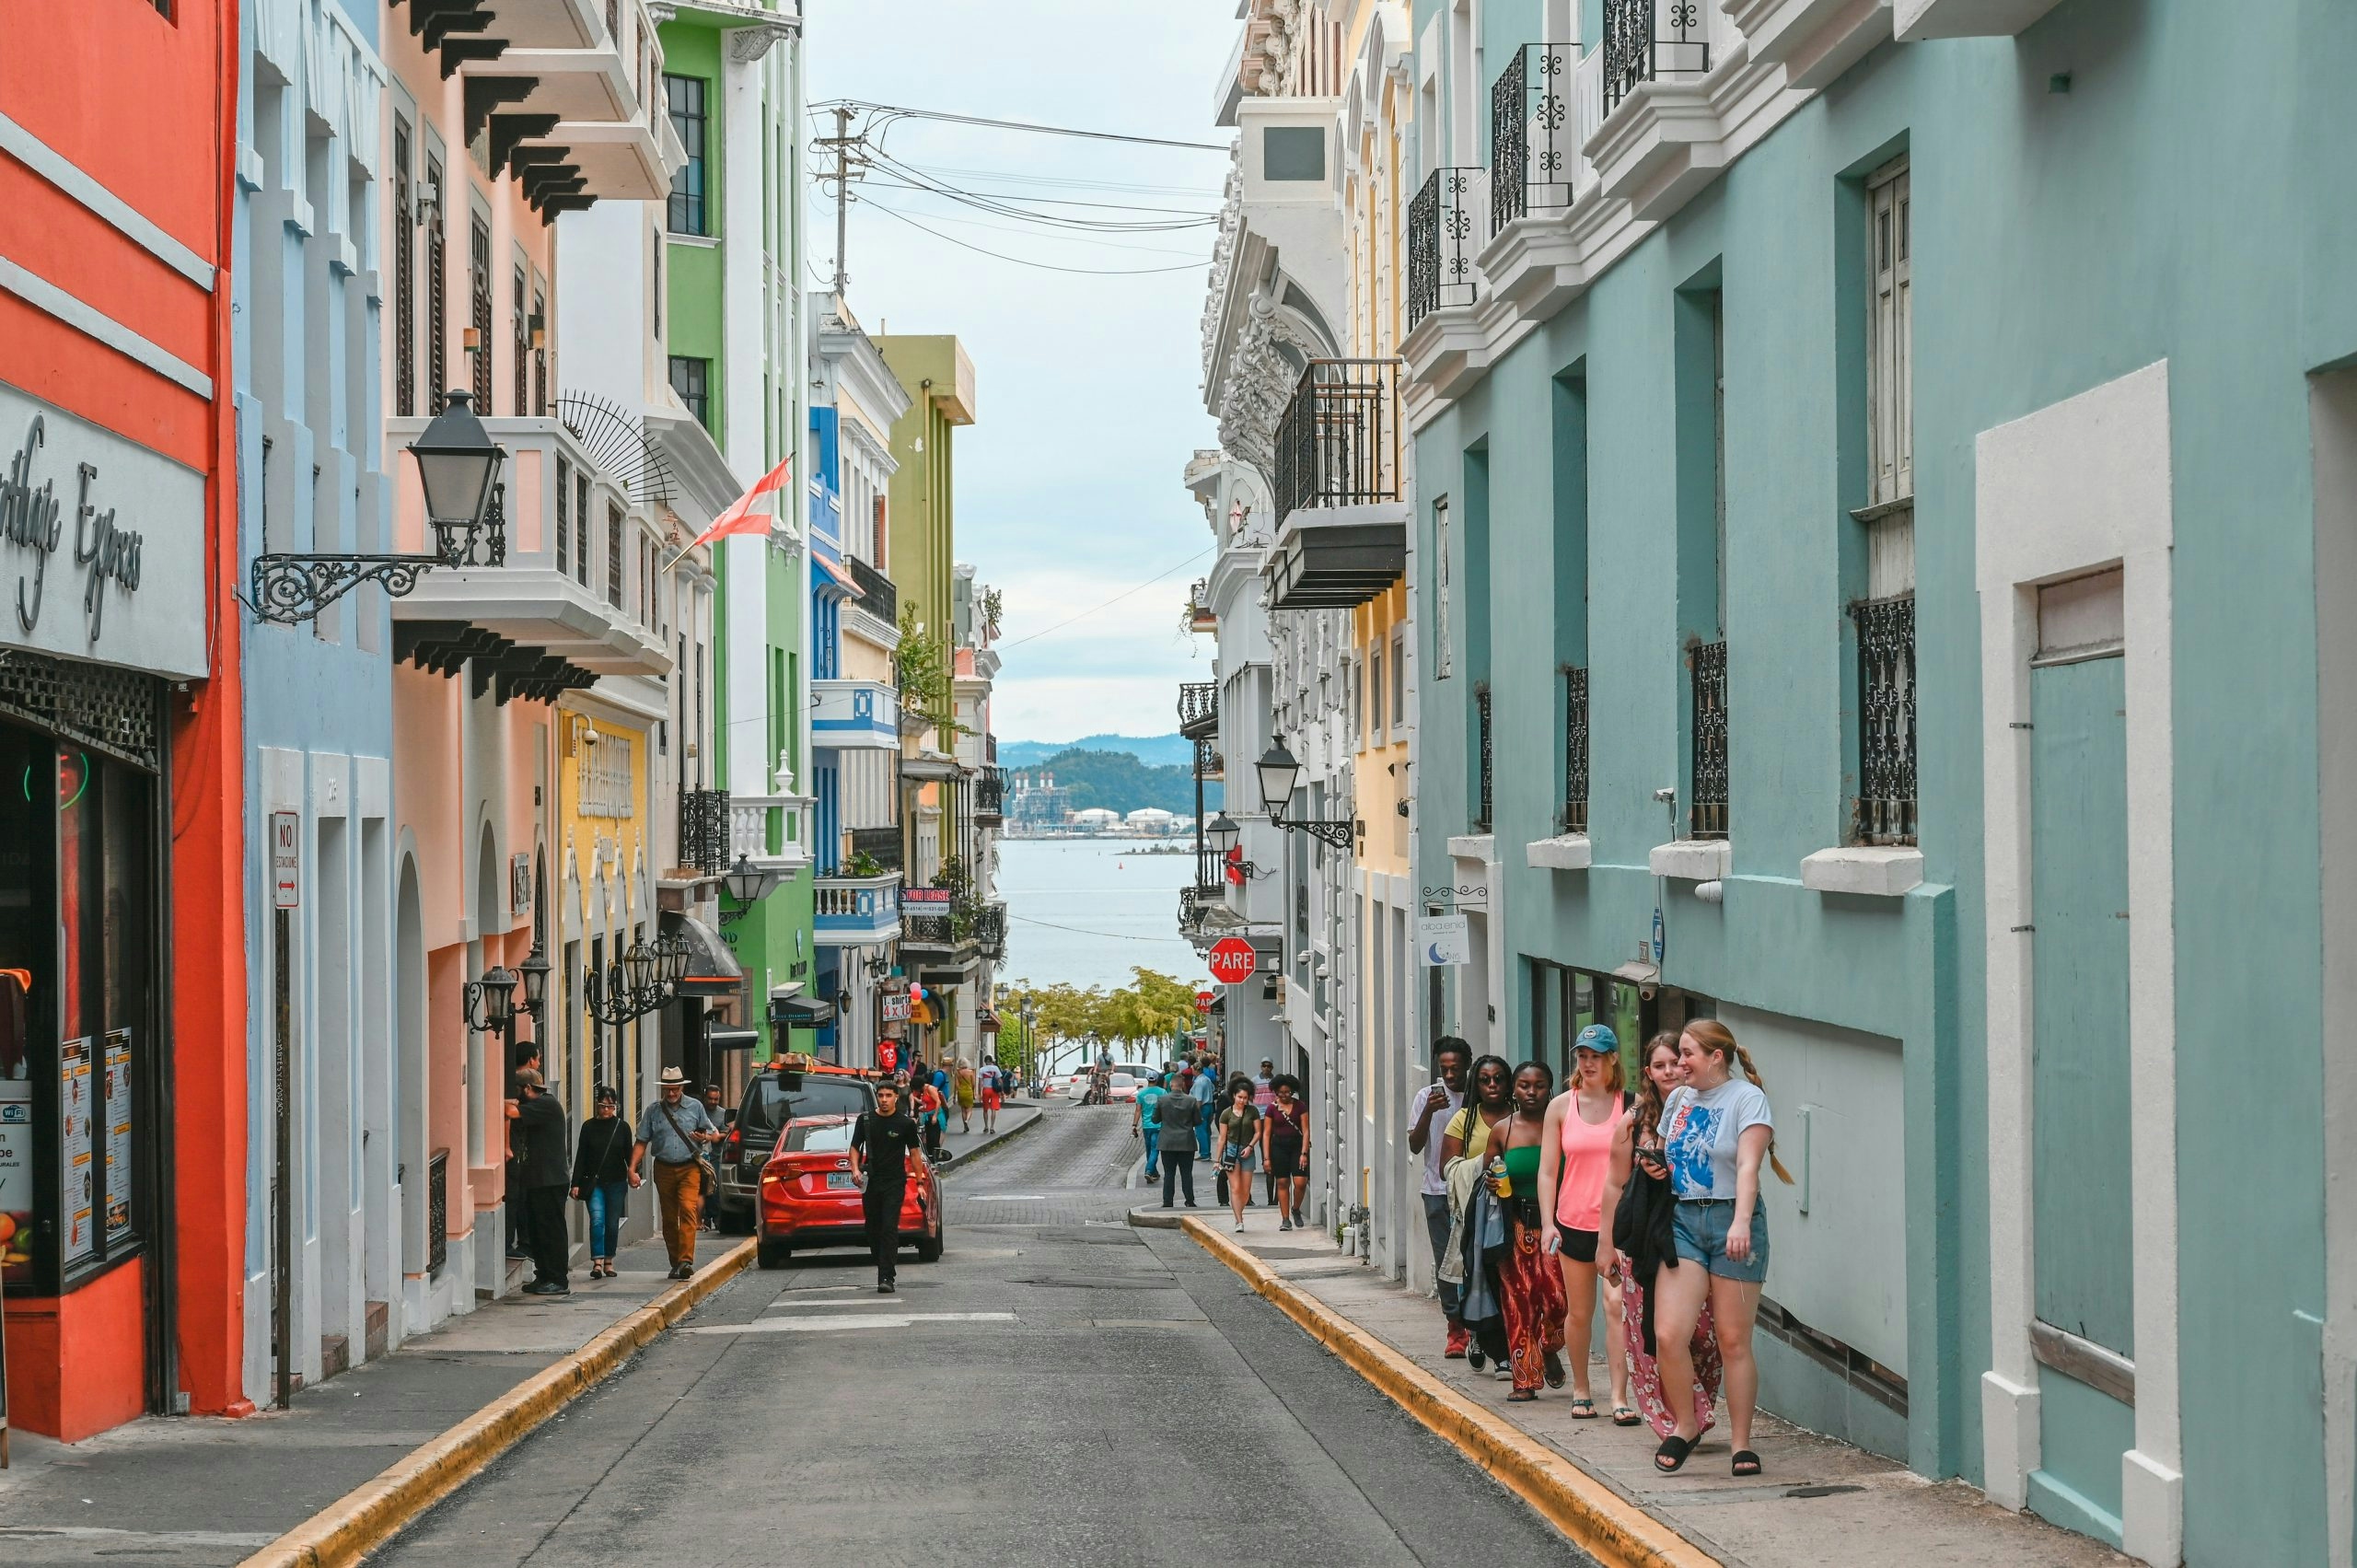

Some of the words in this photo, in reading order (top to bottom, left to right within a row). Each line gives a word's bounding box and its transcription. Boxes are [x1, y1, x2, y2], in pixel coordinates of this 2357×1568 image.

[280, 824, 292, 847] NO
[276, 856, 296, 868] ESTACIONE
[907, 889, 923, 901] FOR
[923, 889, 950, 901] LEASE
[1211, 952, 1253, 970] PARE
[1195, 998, 1212, 1007] PAR
[884, 1005, 890, 1016] 4
[900, 1004, 911, 1016] 10
